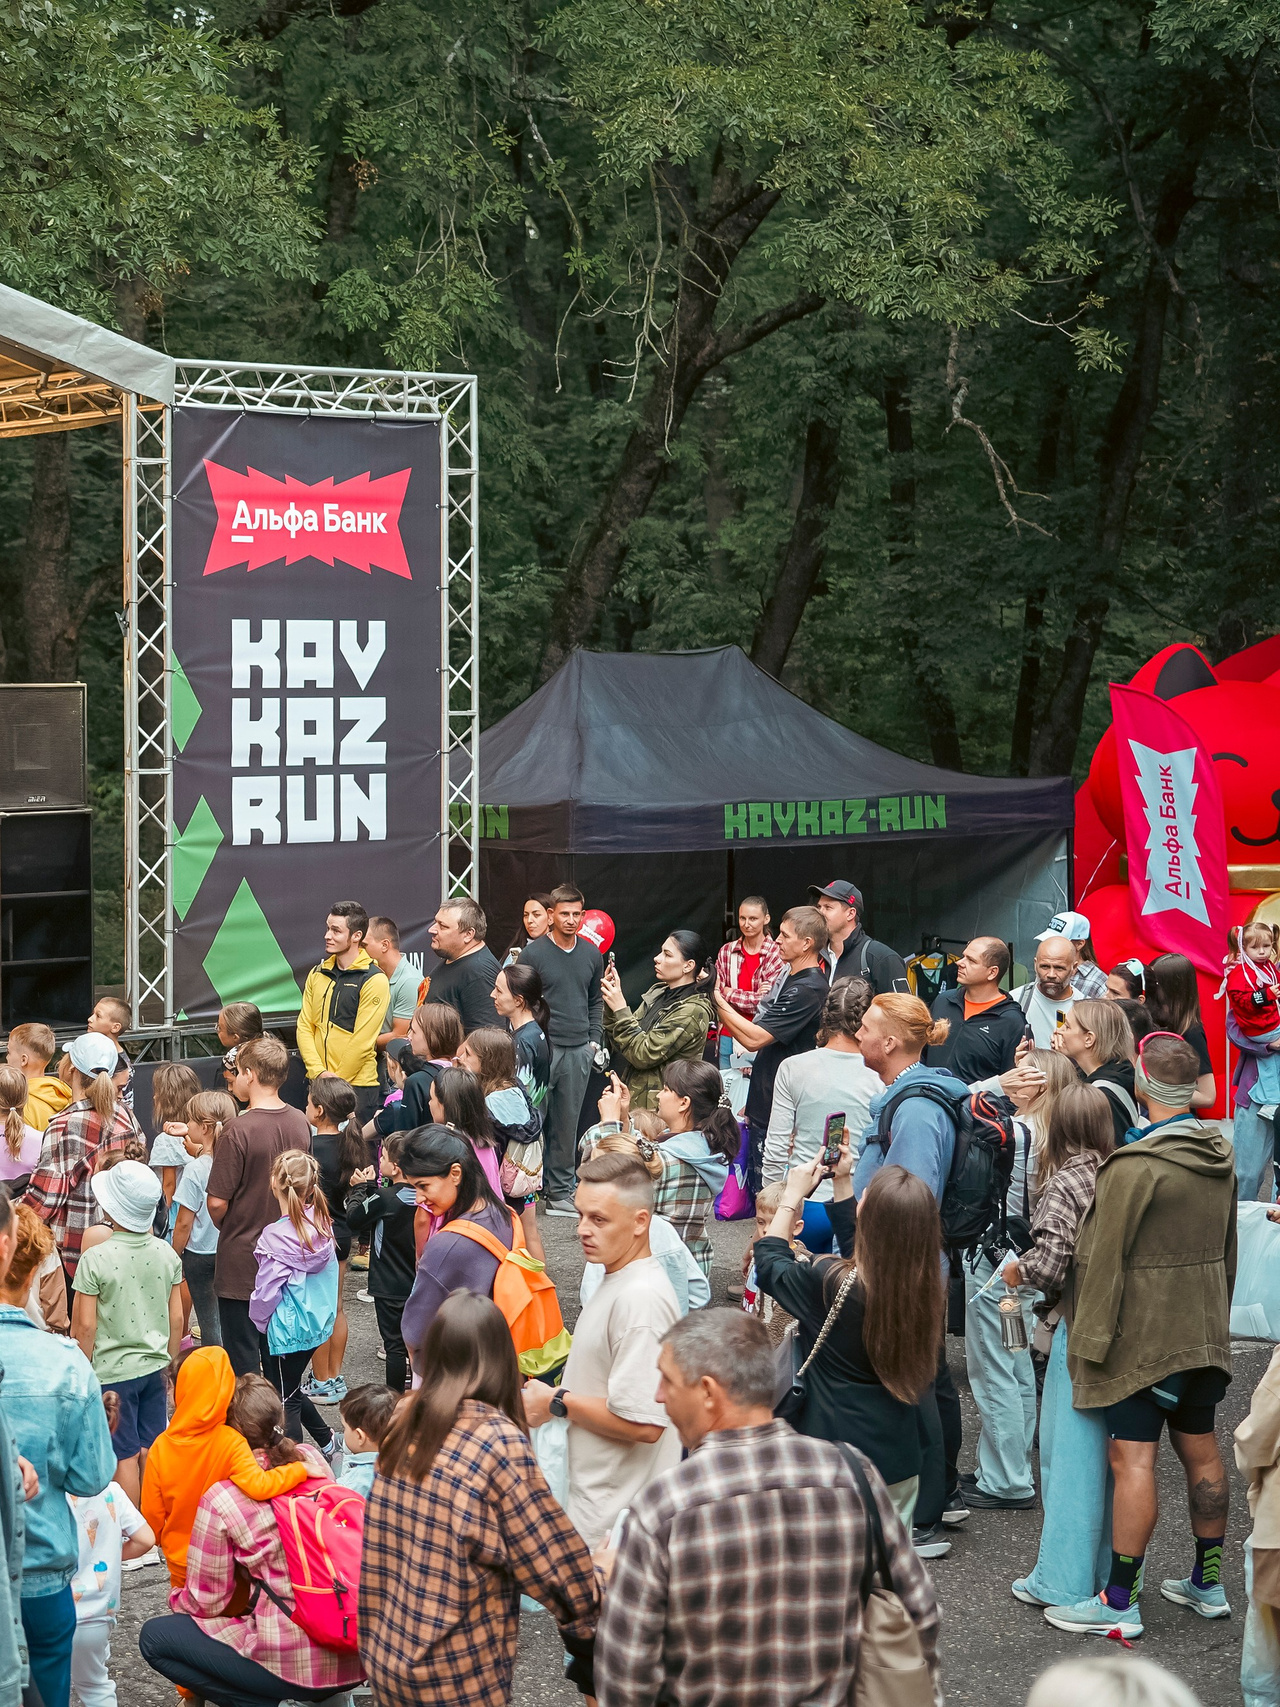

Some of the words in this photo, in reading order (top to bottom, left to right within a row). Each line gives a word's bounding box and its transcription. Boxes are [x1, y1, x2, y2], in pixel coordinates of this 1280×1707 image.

[231, 499, 319, 539] Альфа
[323, 503, 388, 534] Банк
[231, 618, 387, 691] KAV
[231, 697, 387, 768] KAZ
[231, 773, 387, 846] RUN
[1158, 763, 1177, 820] Банк
[1162, 825, 1184, 898] Альфа
